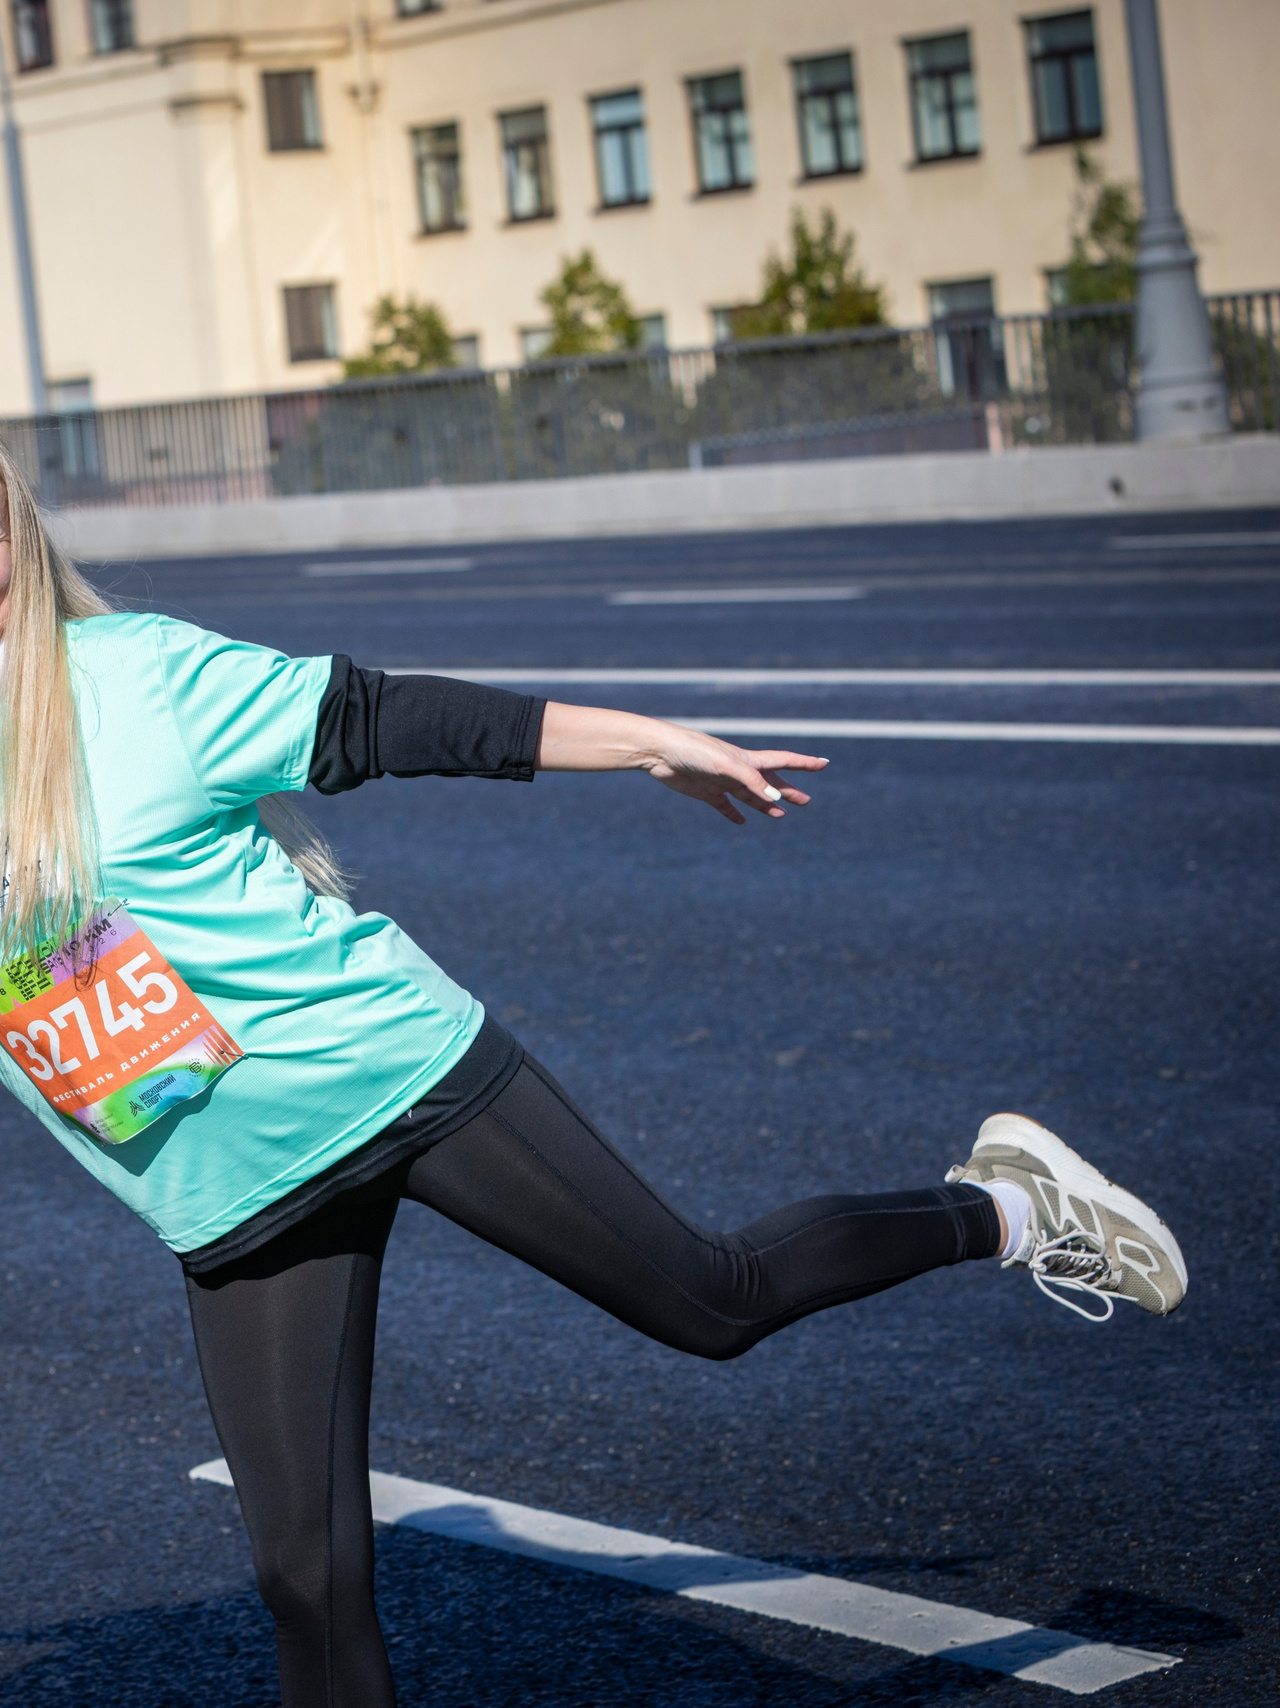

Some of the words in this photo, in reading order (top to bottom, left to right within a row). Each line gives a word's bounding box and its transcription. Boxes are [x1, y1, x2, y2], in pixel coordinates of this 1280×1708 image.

[5, 950, 179, 1082] 32745
[52, 1071, 115, 1104] ФЕСТИВАЛЬ
[120, 1012, 201, 1072] ДВИЖЕНИЯ
[138, 1073, 177, 1102] МОСКОВСКИЙ
[144, 1094, 163, 1109] СПОРТ
